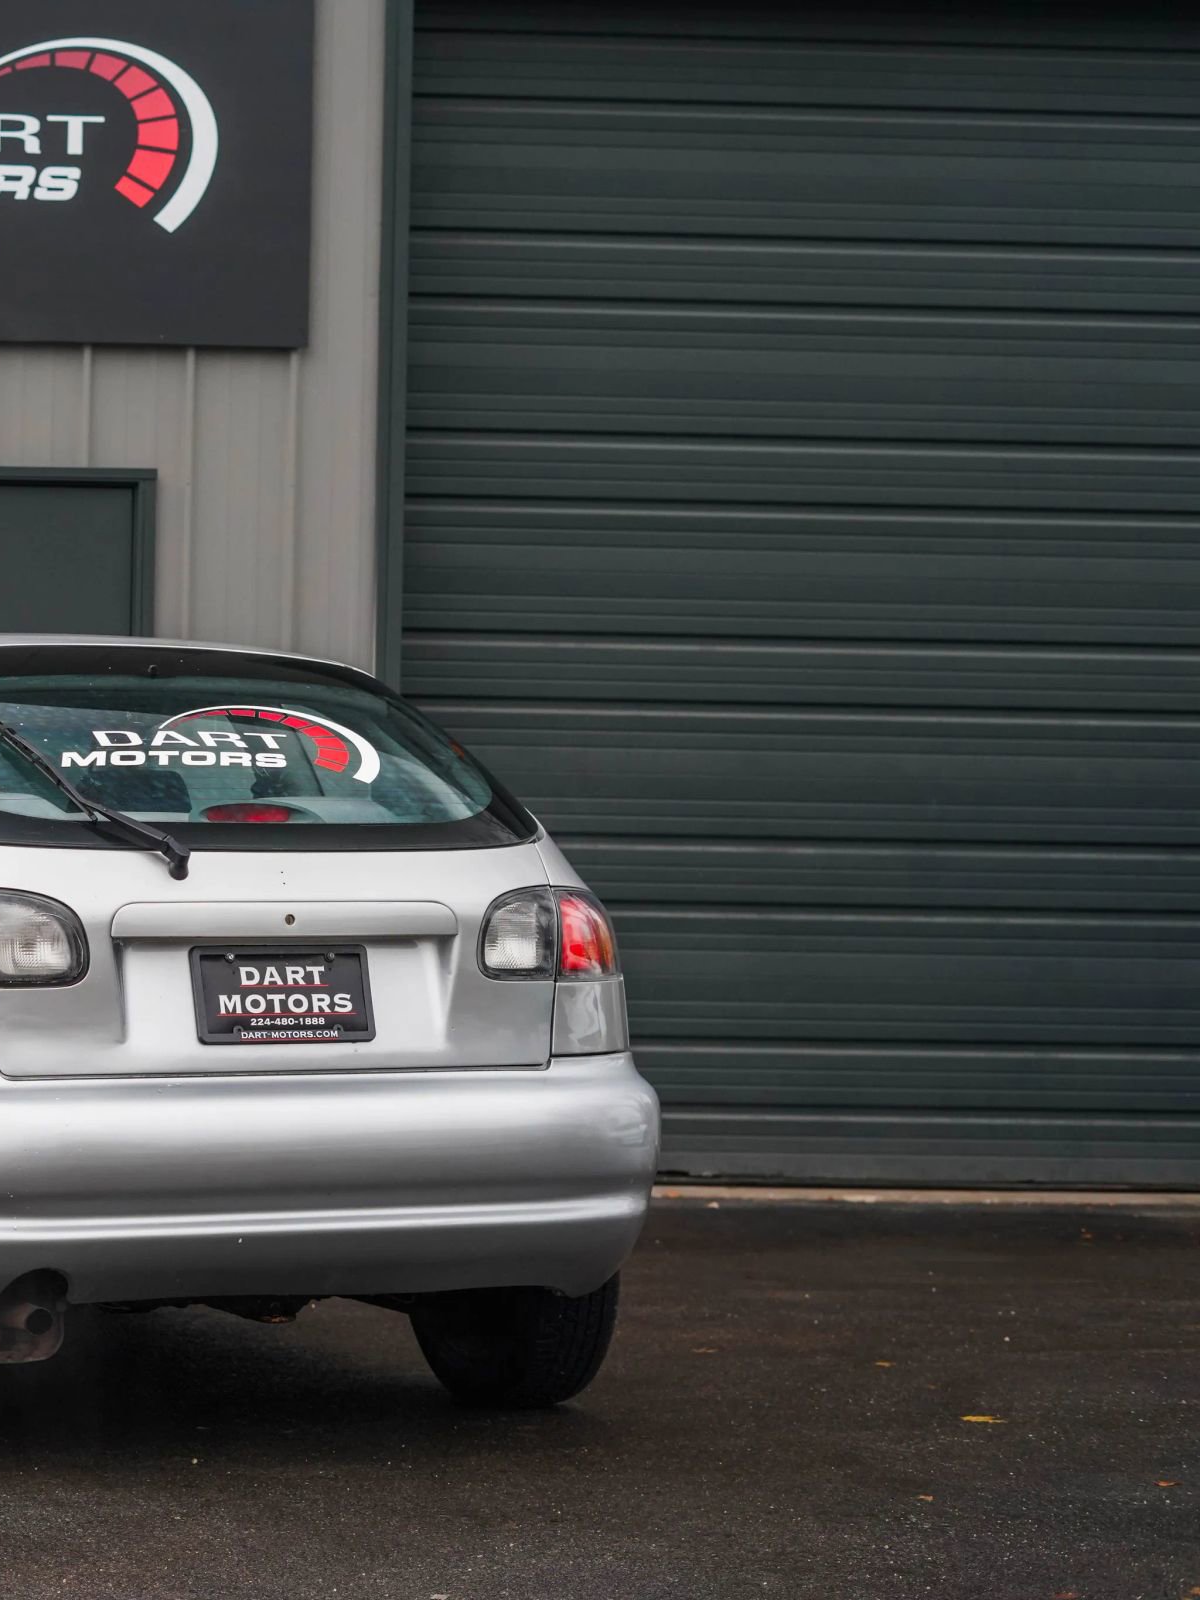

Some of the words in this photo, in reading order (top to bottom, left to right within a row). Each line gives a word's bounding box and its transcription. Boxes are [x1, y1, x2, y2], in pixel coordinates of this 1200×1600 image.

[92, 730, 287, 749] DART
[61, 751, 287, 767] MOTORS
[239, 966, 325, 985] DART
[218, 993, 353, 1014] MOTORS
[250, 1017, 325, 1026] 224-480-1888
[241, 1030, 338, 1039] DART-MOTORS.COM
